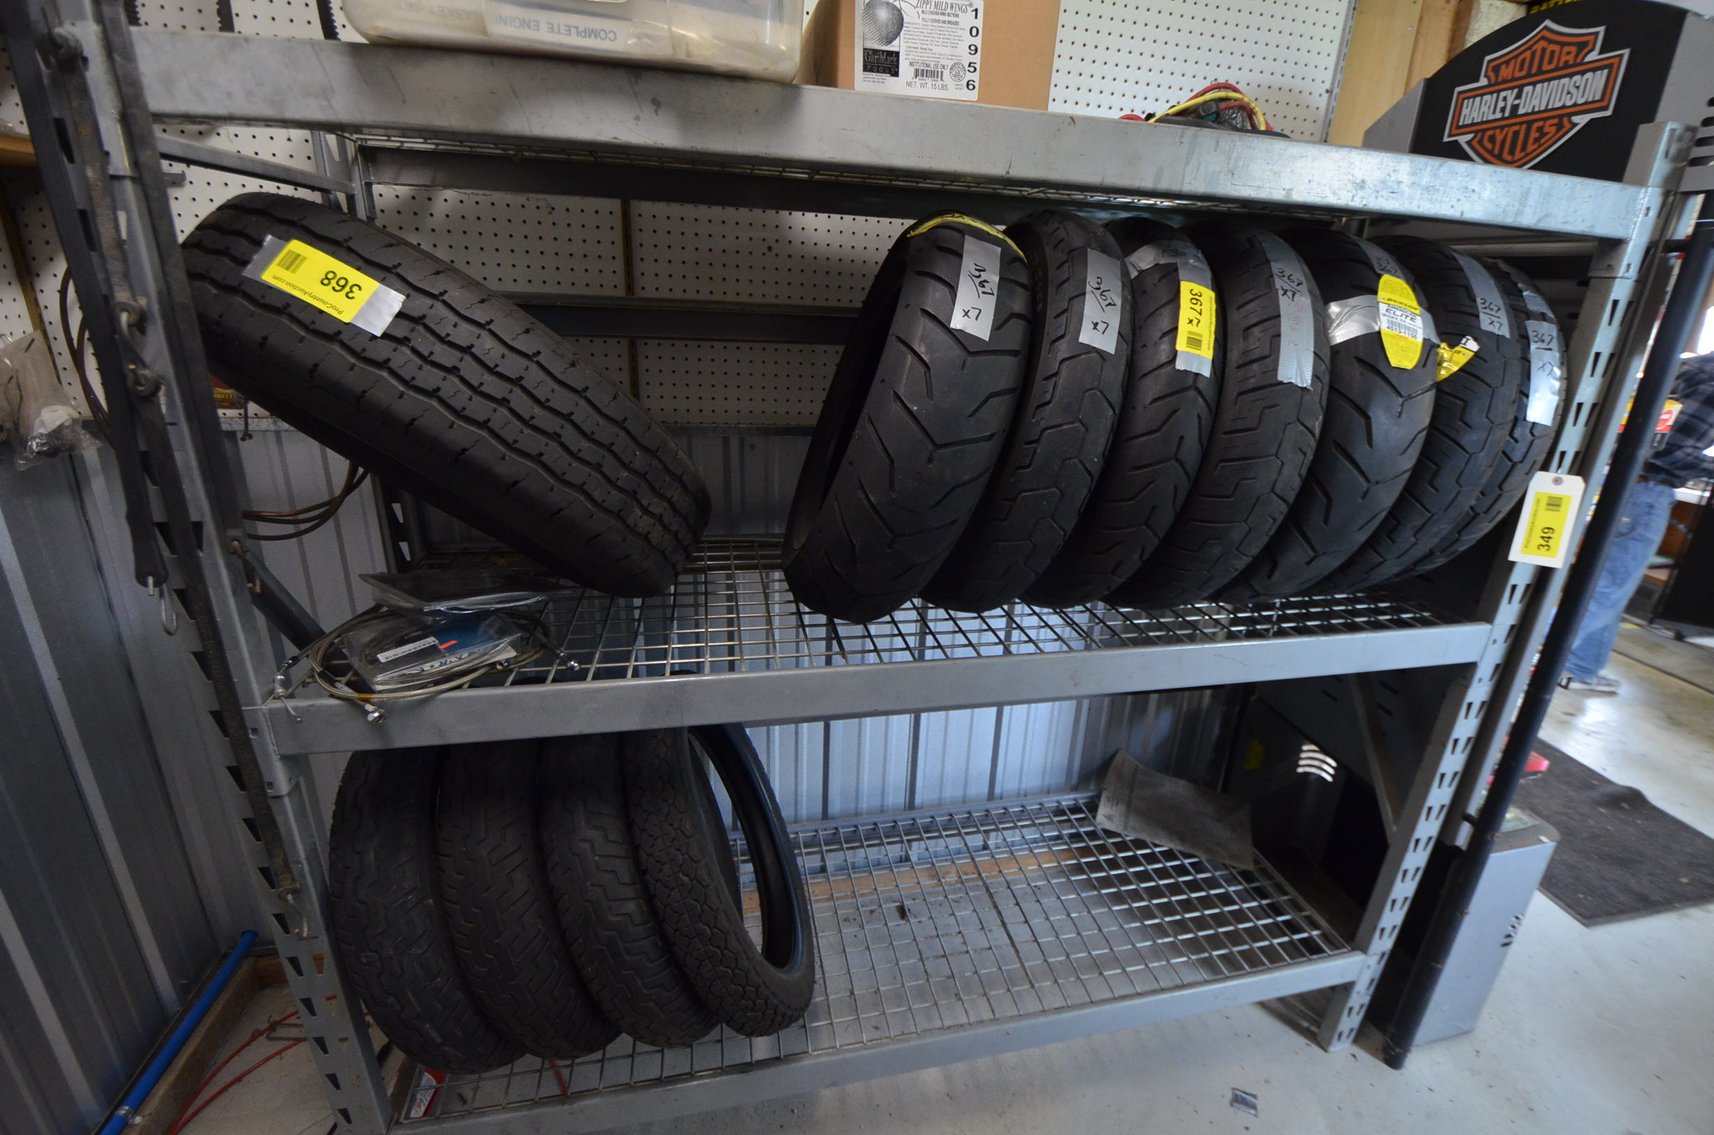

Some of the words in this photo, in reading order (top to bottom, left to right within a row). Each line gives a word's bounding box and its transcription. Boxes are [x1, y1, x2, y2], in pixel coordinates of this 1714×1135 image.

[934, 0, 949, 11] MILD
[495, 15, 541, 32] ENGIN
[547, 21, 618, 42] COMPLETE
[1499, 40, 1579, 81] MOTOR
[930, 82, 938, 90] 15
[1458, 67, 1610, 127] HARLEY-DAVIDSON
[1482, 117, 1560, 162] CYCLES
[319, 270, 363, 301] 368
[968, 262, 996, 297] 367
[1277, 267, 1304, 288] 367
[272, 274, 345, 316] ProCountryAuction.com
[1088, 276, 1118, 308] 367
[1188, 288, 1203, 316] 367
[1385, 307, 1418, 324] ELITE
[1479, 297, 1502, 313] 367
[1531, 329, 1554, 346] 367
[1537, 526, 1555, 551] 349
